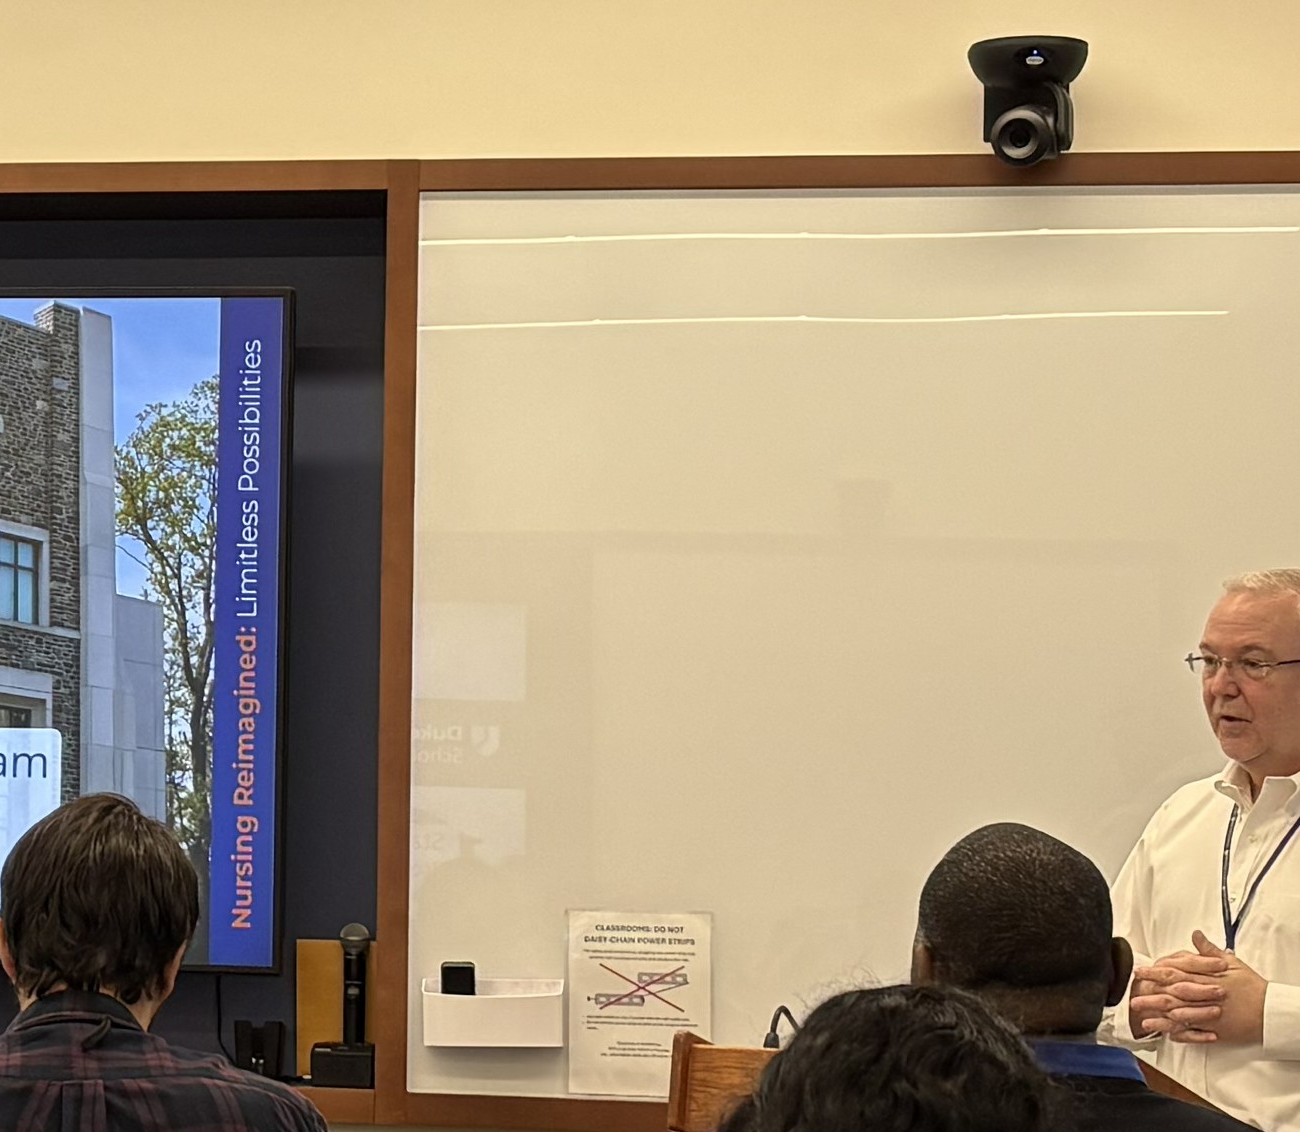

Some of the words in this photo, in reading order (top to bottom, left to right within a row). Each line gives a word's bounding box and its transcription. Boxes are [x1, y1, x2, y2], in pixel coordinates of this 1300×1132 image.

[237, 338, 262, 494] Possibilities
[236, 500, 259, 618] Limitless
[231, 626, 261, 806] Reimagined:
[230, 812, 259, 930] Nursing
